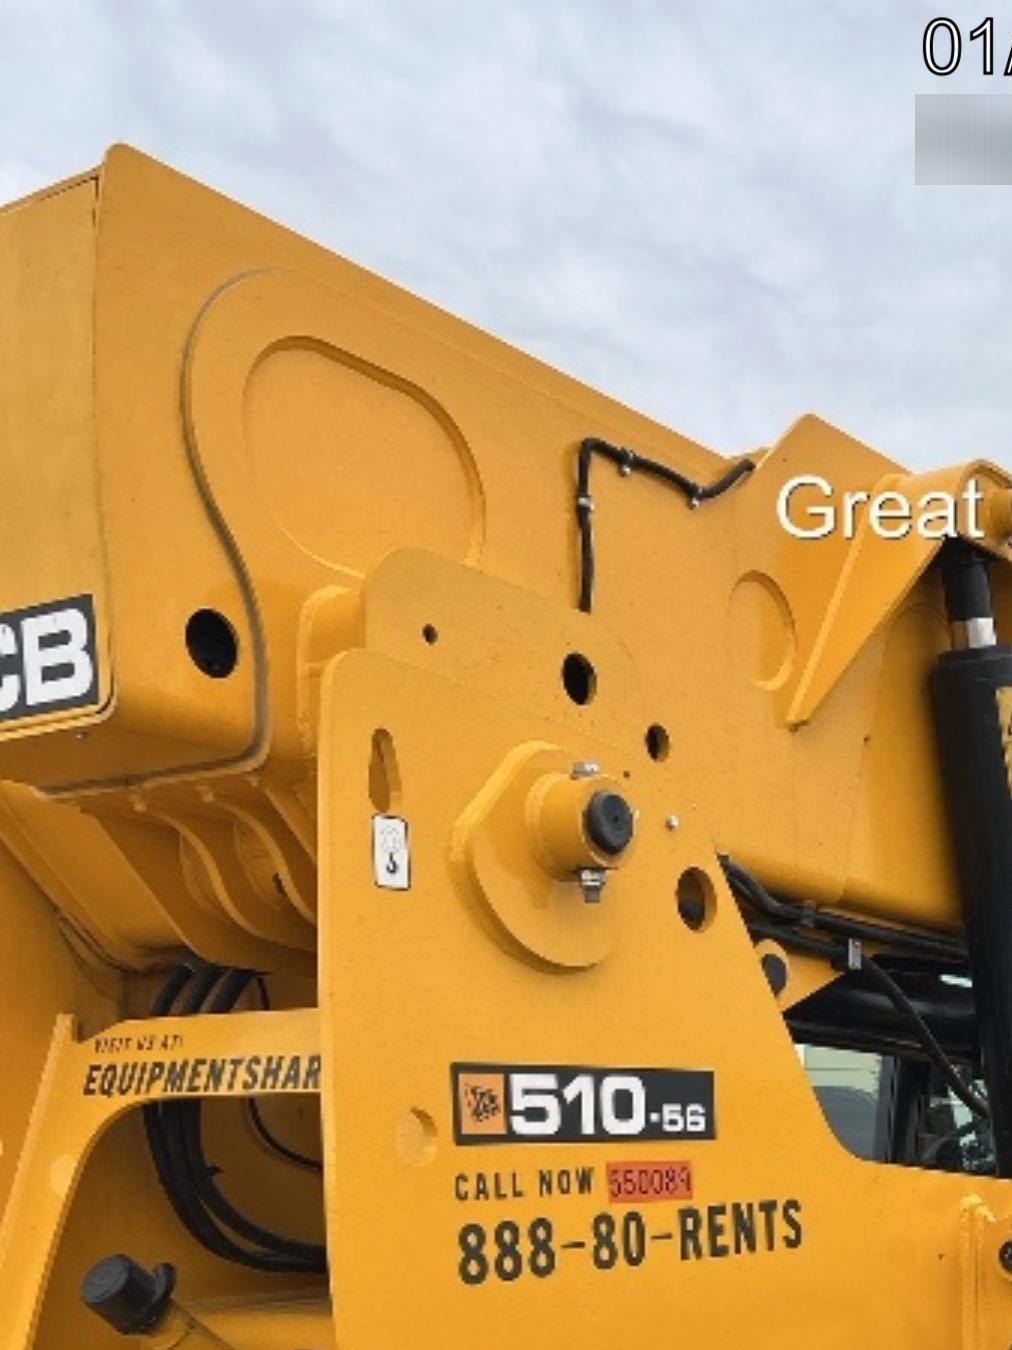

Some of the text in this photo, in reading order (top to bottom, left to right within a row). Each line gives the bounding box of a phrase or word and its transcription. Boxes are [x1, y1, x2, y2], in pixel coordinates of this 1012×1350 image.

[454, 1166, 595, 1201] CALL NOW
[457, 1198, 803, 1286] 888-80-RENTS
